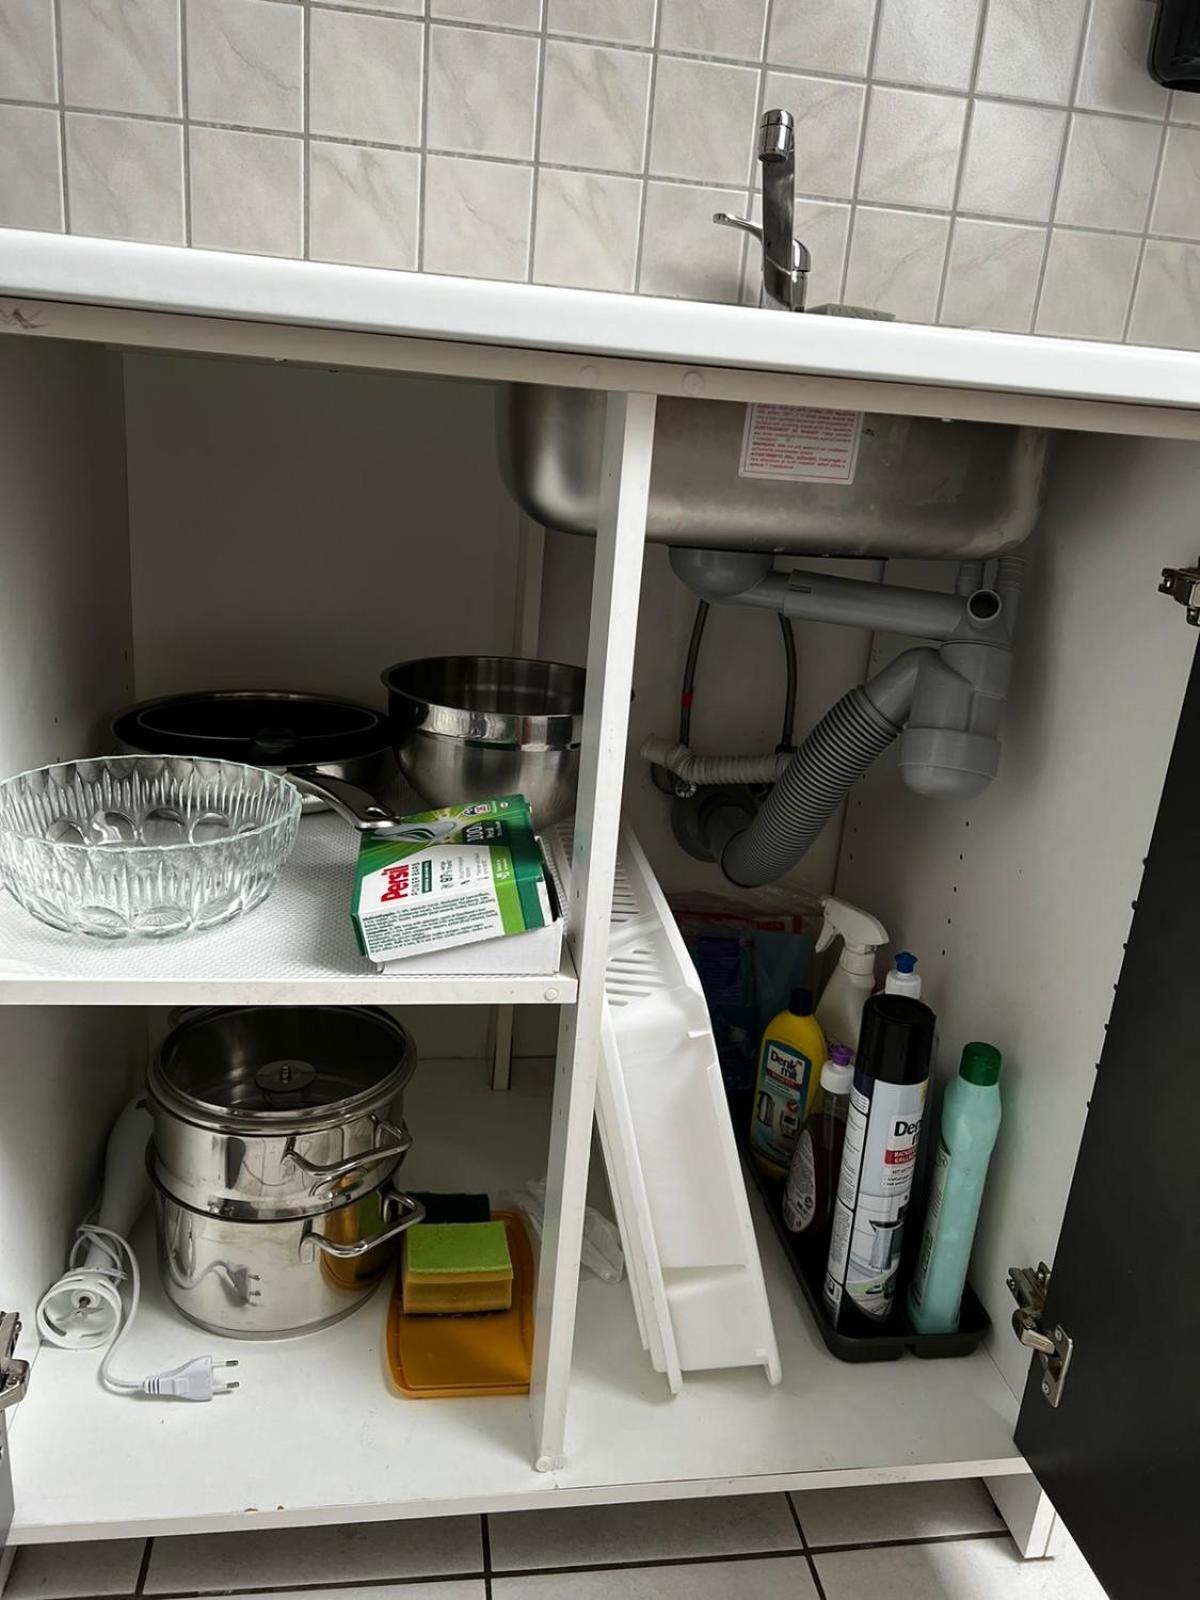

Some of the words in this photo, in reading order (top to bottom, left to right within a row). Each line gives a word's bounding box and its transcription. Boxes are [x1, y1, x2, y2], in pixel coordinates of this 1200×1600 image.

[381, 864, 409, 902] Persil
[770, 1050, 803, 1070] Denk
[894, 1119, 920, 1137] Den
